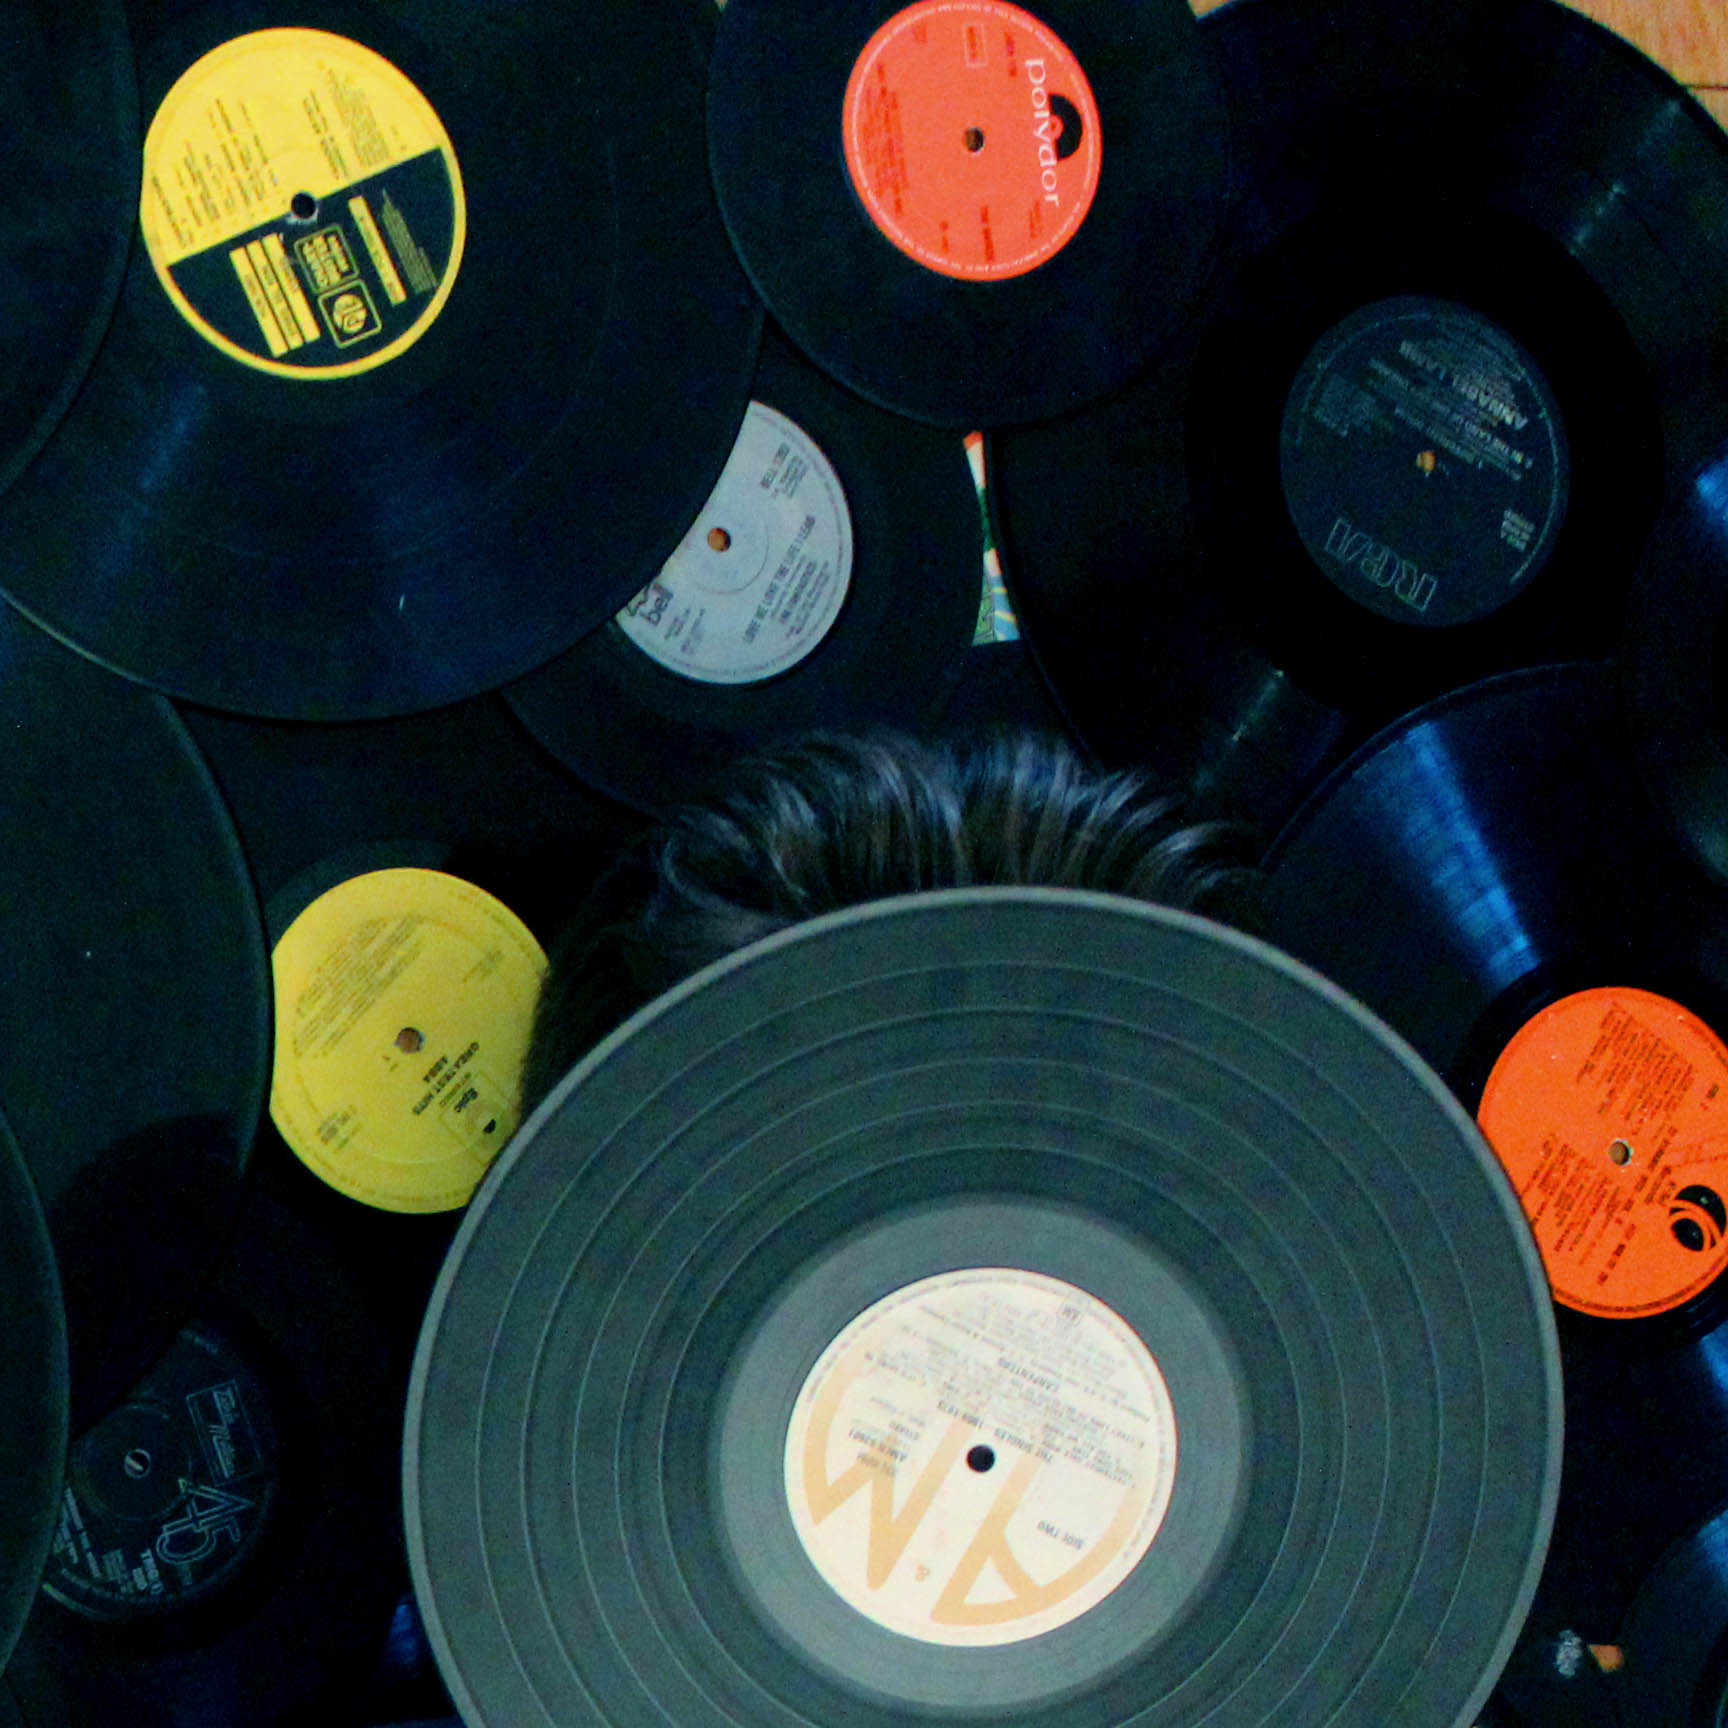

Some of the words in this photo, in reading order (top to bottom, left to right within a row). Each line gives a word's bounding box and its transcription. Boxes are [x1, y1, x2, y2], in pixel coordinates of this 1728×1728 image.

[1023, 58, 1059, 208] polydor
[420, 1054, 451, 1086] ABBA
[429, 1040, 483, 1094] GREATEST
[409, 1090, 437, 1117] HITS
[451, 1086, 481, 1116] Epic
[993, 1355, 1063, 1394] CARPENTERS
[156, 1478, 253, 1564] 45
